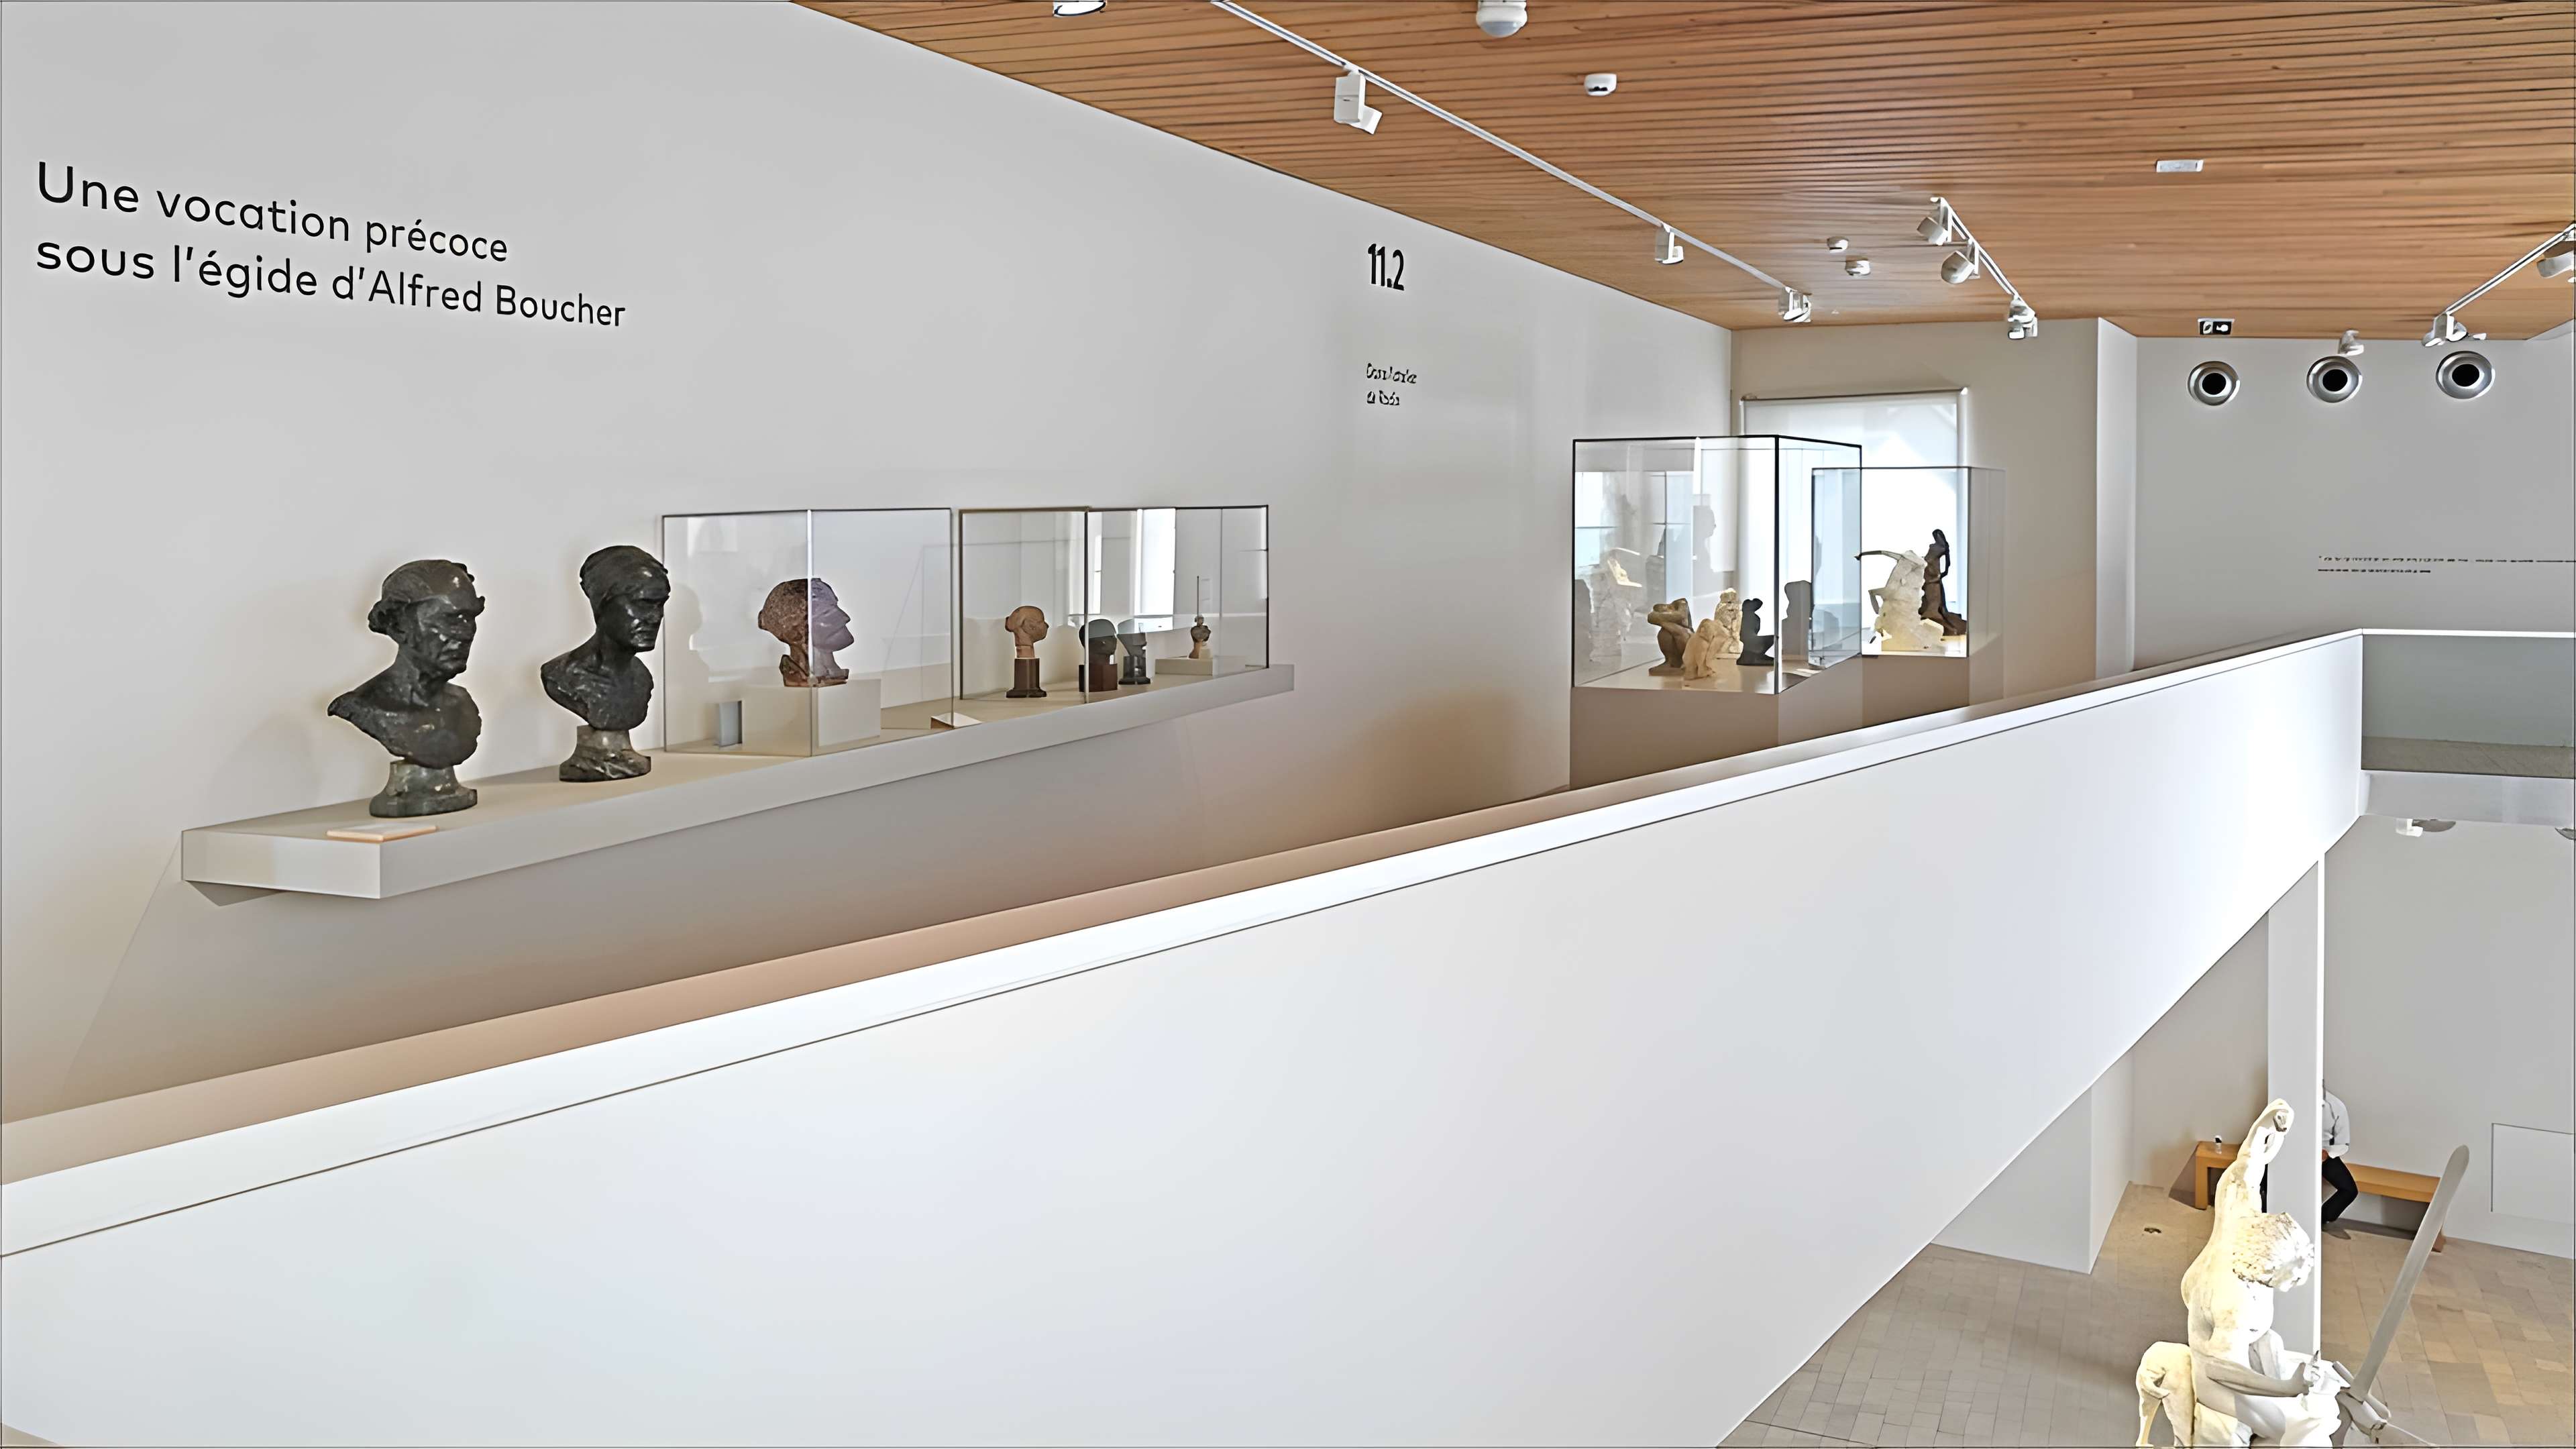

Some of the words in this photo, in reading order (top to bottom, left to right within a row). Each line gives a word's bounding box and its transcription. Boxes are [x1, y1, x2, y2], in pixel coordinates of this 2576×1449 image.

[38, 160, 140, 213] Une
[156, 189, 350, 242] vocation
[366, 218, 508, 263] précoce
[36, 241, 155, 280] sous
[173, 244, 318, 299] l'égide
[331, 264, 482, 313] d'Alfred
[496, 284, 627, 327] Boucher
[1367, 242, 1405, 291] 11.2
